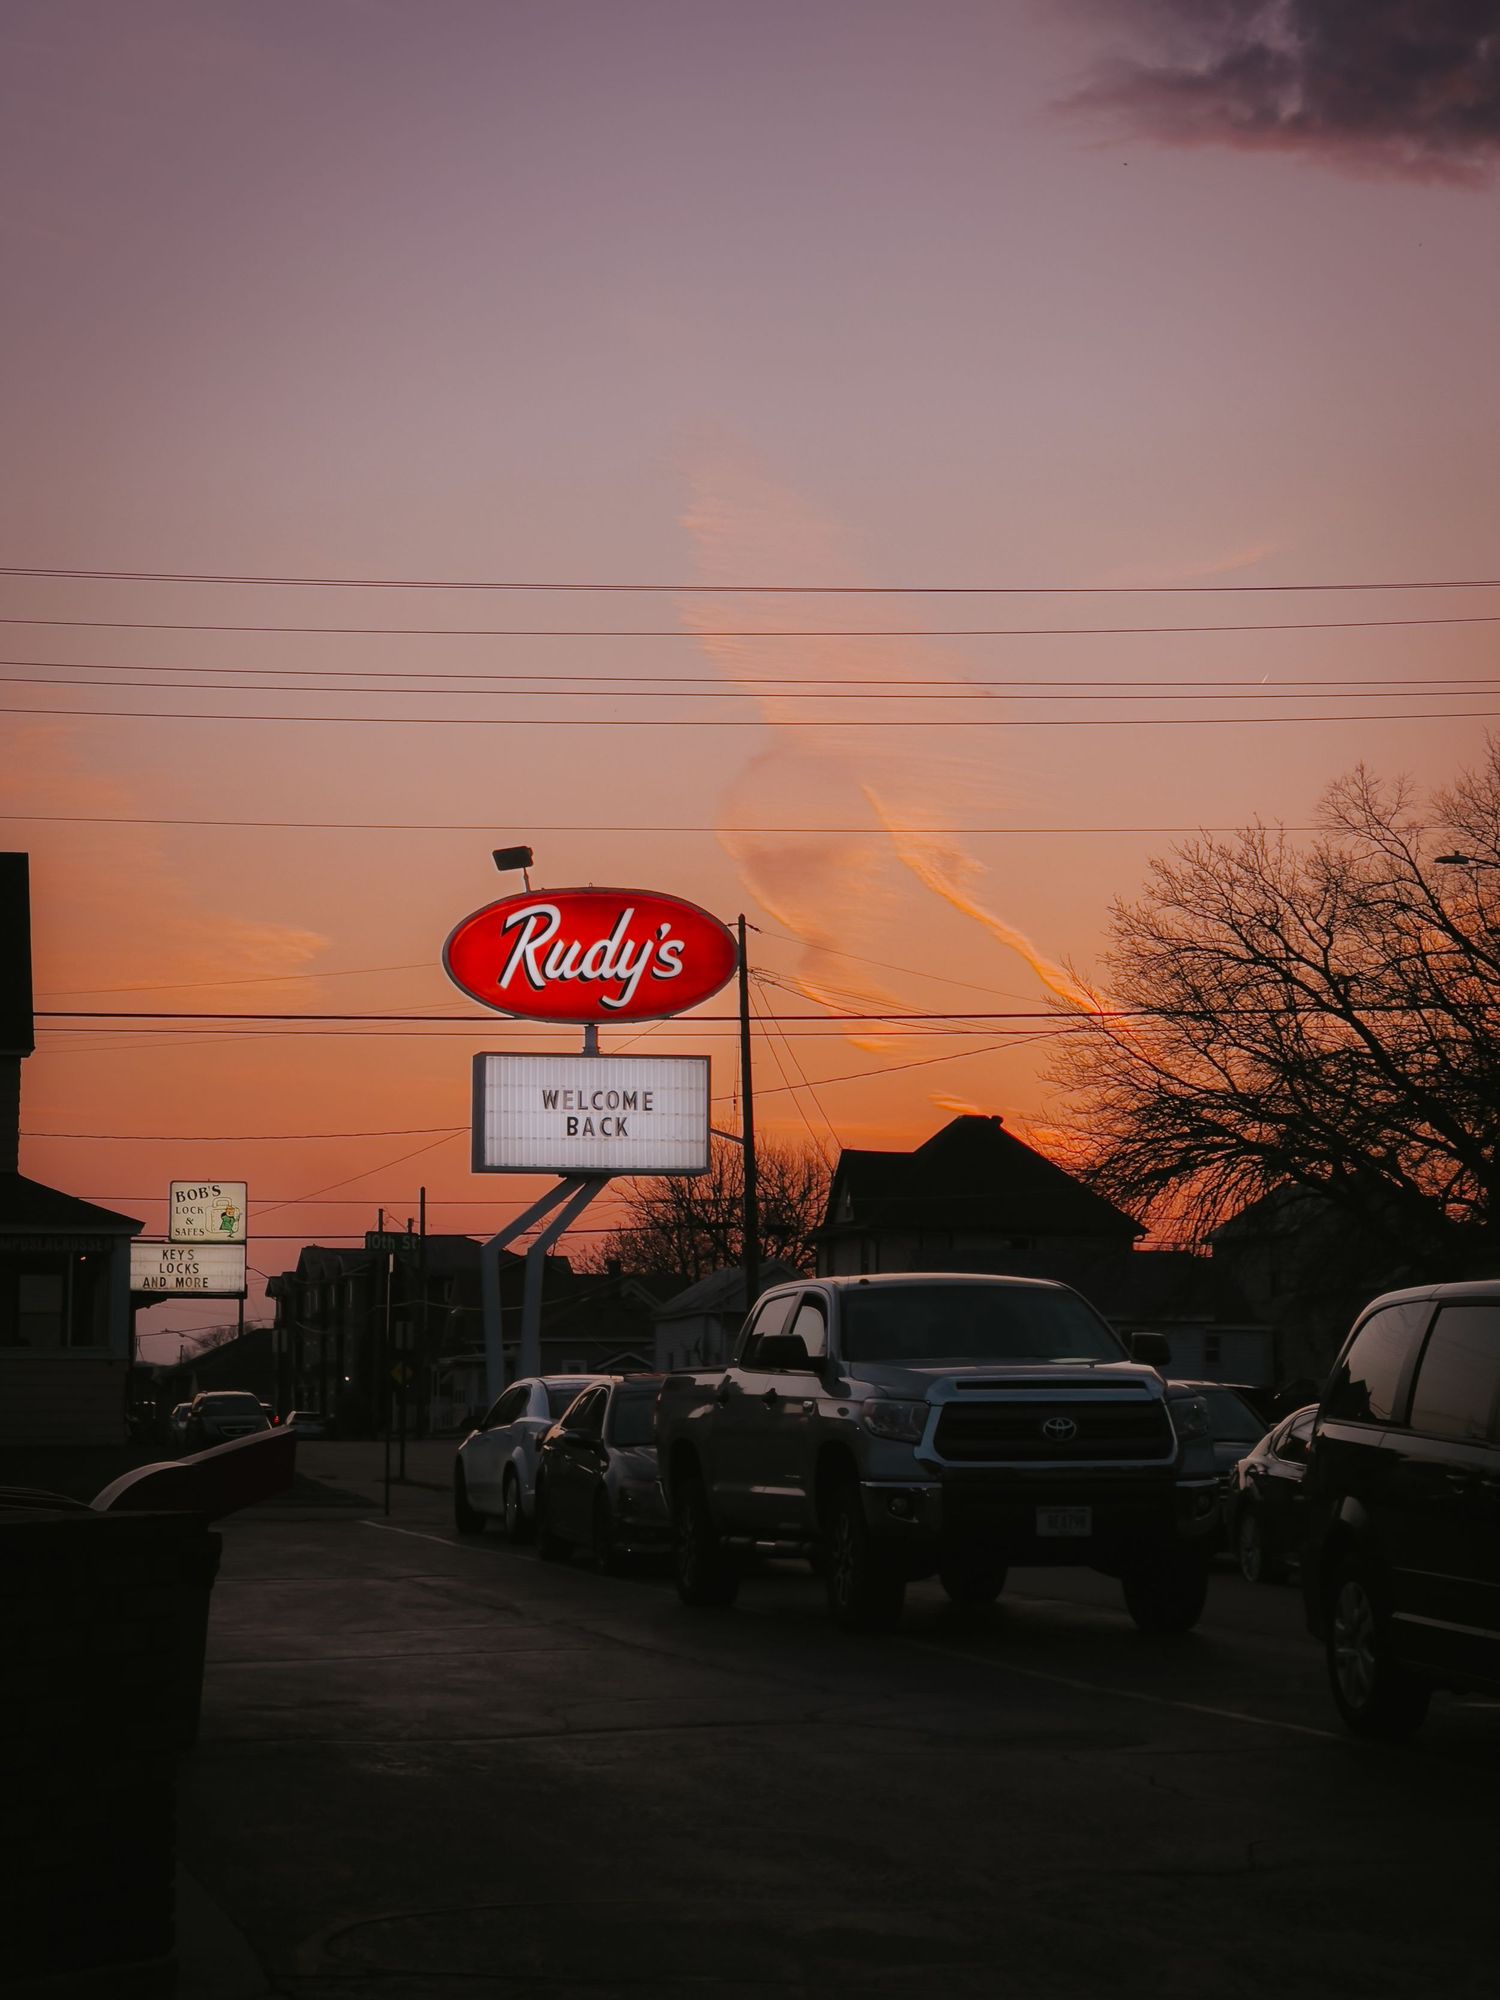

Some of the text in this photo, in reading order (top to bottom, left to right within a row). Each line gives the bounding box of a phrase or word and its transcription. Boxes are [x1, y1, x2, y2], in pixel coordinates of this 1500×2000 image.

[497, 904, 685, 1009] Rudy's
[542, 1089, 653, 1111] WELCOME
[566, 1116, 629, 1137] BACK
[175, 1184, 221, 1203] BOB'S
[175, 1206, 204, 1215] LOCK
[186, 1217, 194, 1225] &
[175, 1228, 205, 1237] SAFES
[162, 1249, 195, 1260] KEYS
[159, 1263, 200, 1274] LOCKS
[143, 1277, 209, 1289] AND MORE
